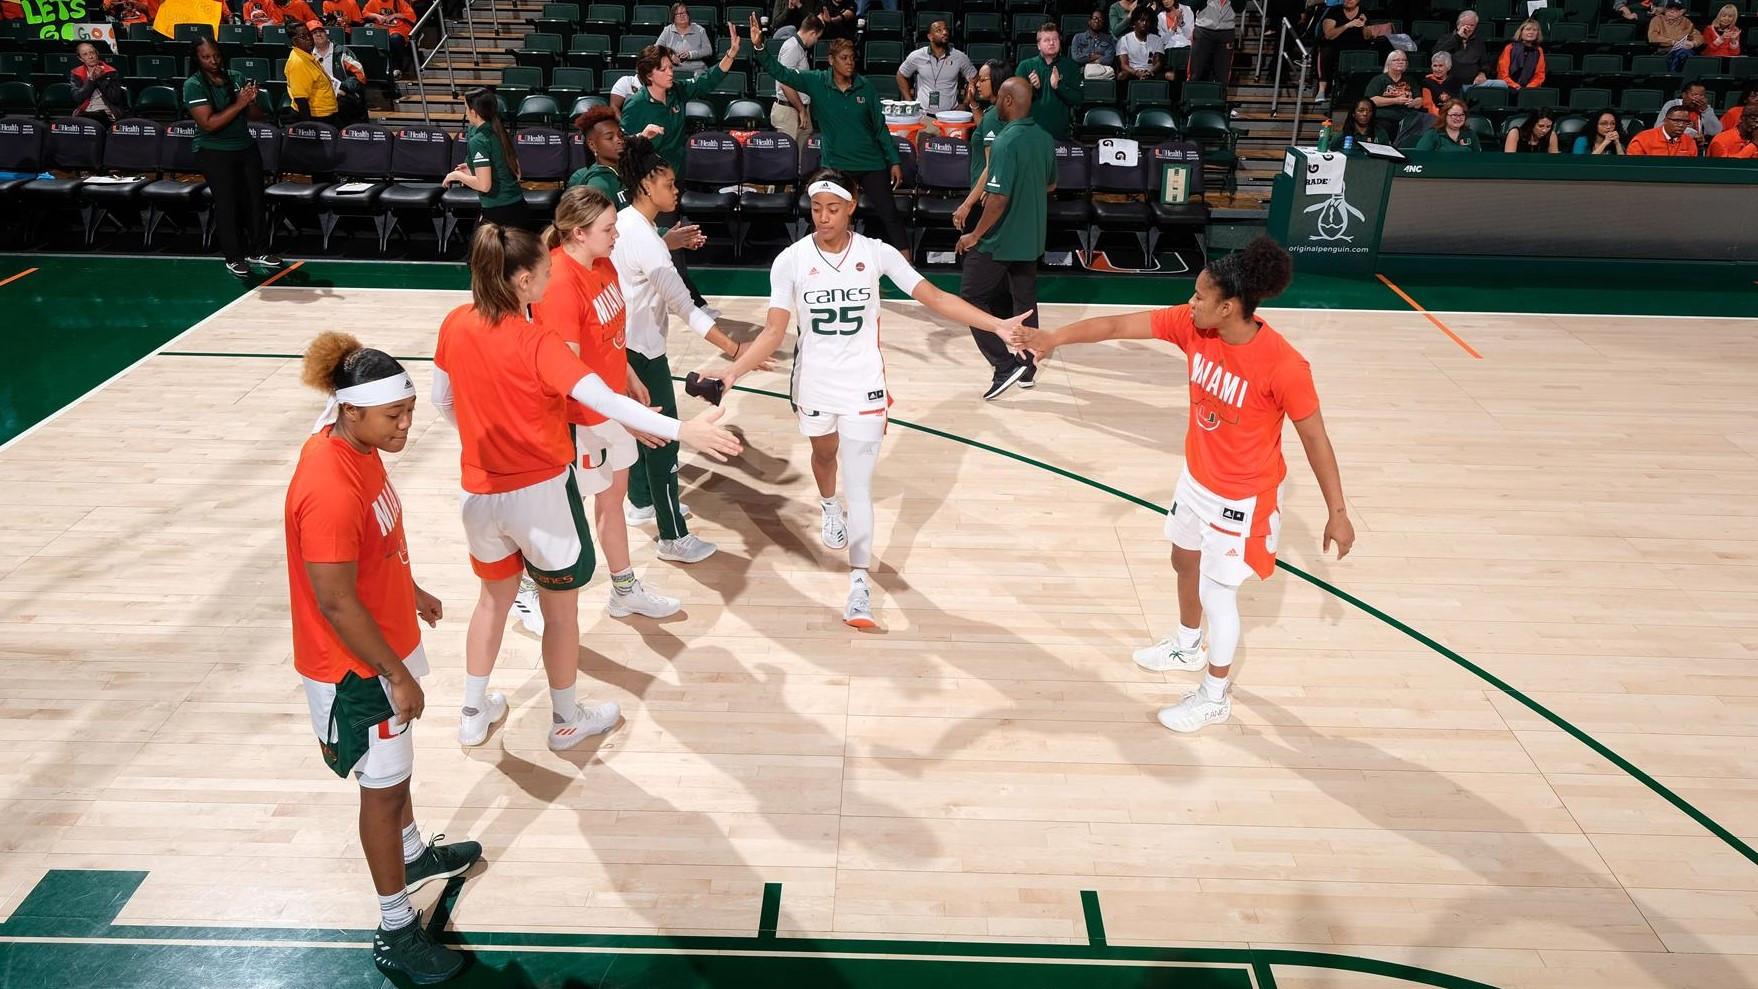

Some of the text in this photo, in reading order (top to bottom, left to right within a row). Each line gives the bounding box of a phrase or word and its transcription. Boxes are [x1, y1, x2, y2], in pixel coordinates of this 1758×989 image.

[22, 0, 86, 24] LETS
[1403, 165, 1423, 173] ANC
[1288, 244, 1370, 254] originalpenguin.com
[810, 305, 866, 337] 25
[1190, 352, 1248, 408] MIAMI
